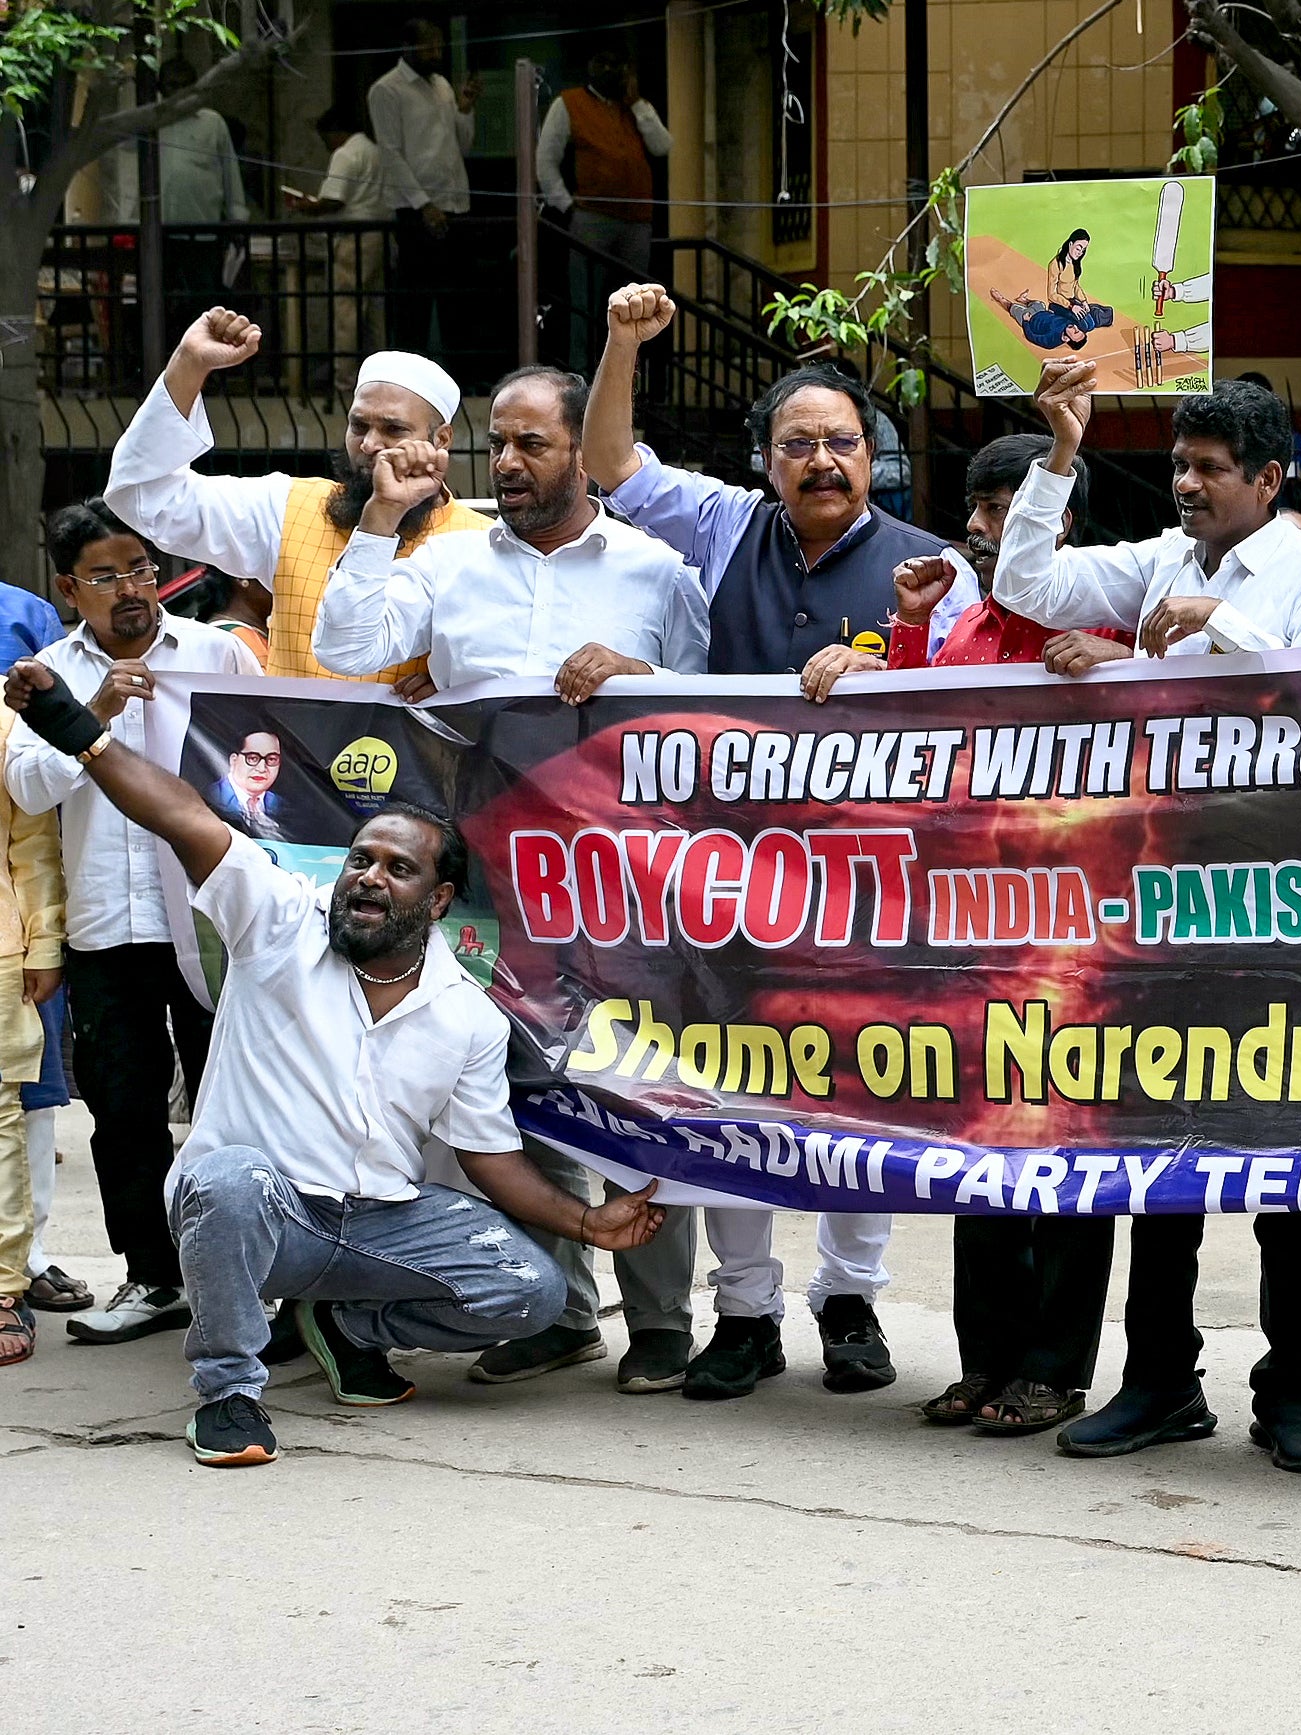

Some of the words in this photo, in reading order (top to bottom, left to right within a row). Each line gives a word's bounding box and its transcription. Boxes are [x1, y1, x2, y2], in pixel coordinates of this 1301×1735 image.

[337, 753, 391, 793] aap
[619, 727, 700, 804] NO
[708, 727, 965, 802] CRICKET
[967, 718, 1134, 799] WITH
[509, 827, 917, 949] BOYCOTT
[927, 865, 1098, 947] INDIA
[1099, 896, 1131, 924] -
[566, 997, 833, 1098] Shame
[856, 1022, 956, 1101] on
[914, 1146, 1178, 1216] PARTY
